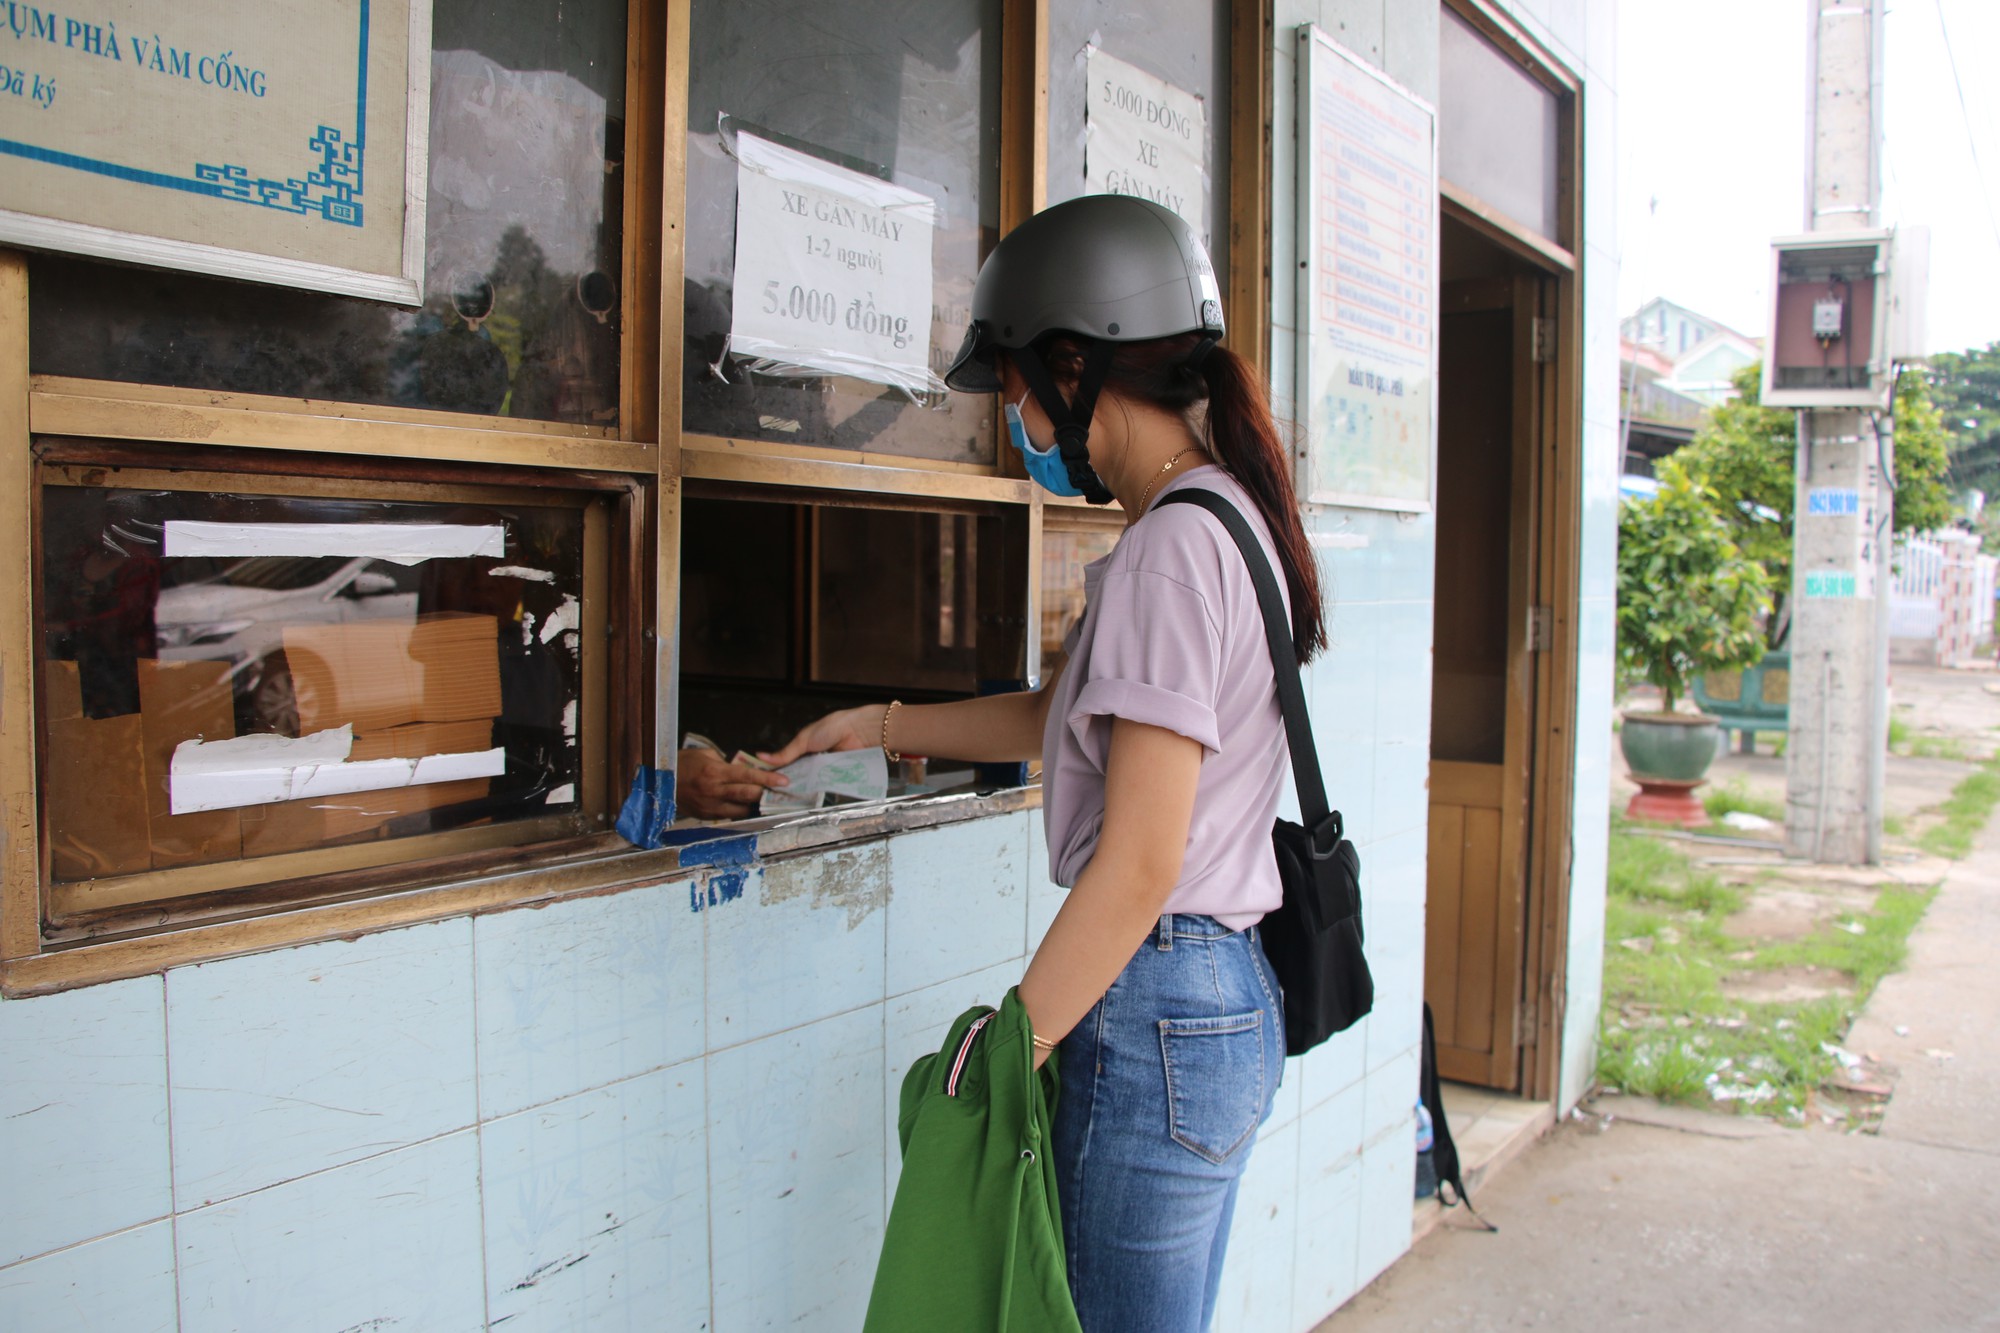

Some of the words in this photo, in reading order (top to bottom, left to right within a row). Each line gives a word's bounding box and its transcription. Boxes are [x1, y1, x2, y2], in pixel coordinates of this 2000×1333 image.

[65, 18, 122, 61] PHÀ
[131, 34, 191, 79] VÀM
[199, 51, 267, 97] CỐNG
[0, 64, 24, 96] Đã
[32, 74, 57, 109] ký
[1103, 81, 1143, 117] 5.000
[1136, 139, 1159, 169] XE
[782, 190, 809, 217] XE
[861, 213, 903, 241] MÁY
[1148, 185, 1184, 216] MÁY
[805, 234, 832, 258] 1-2
[762, 280, 837, 326] 5.000
